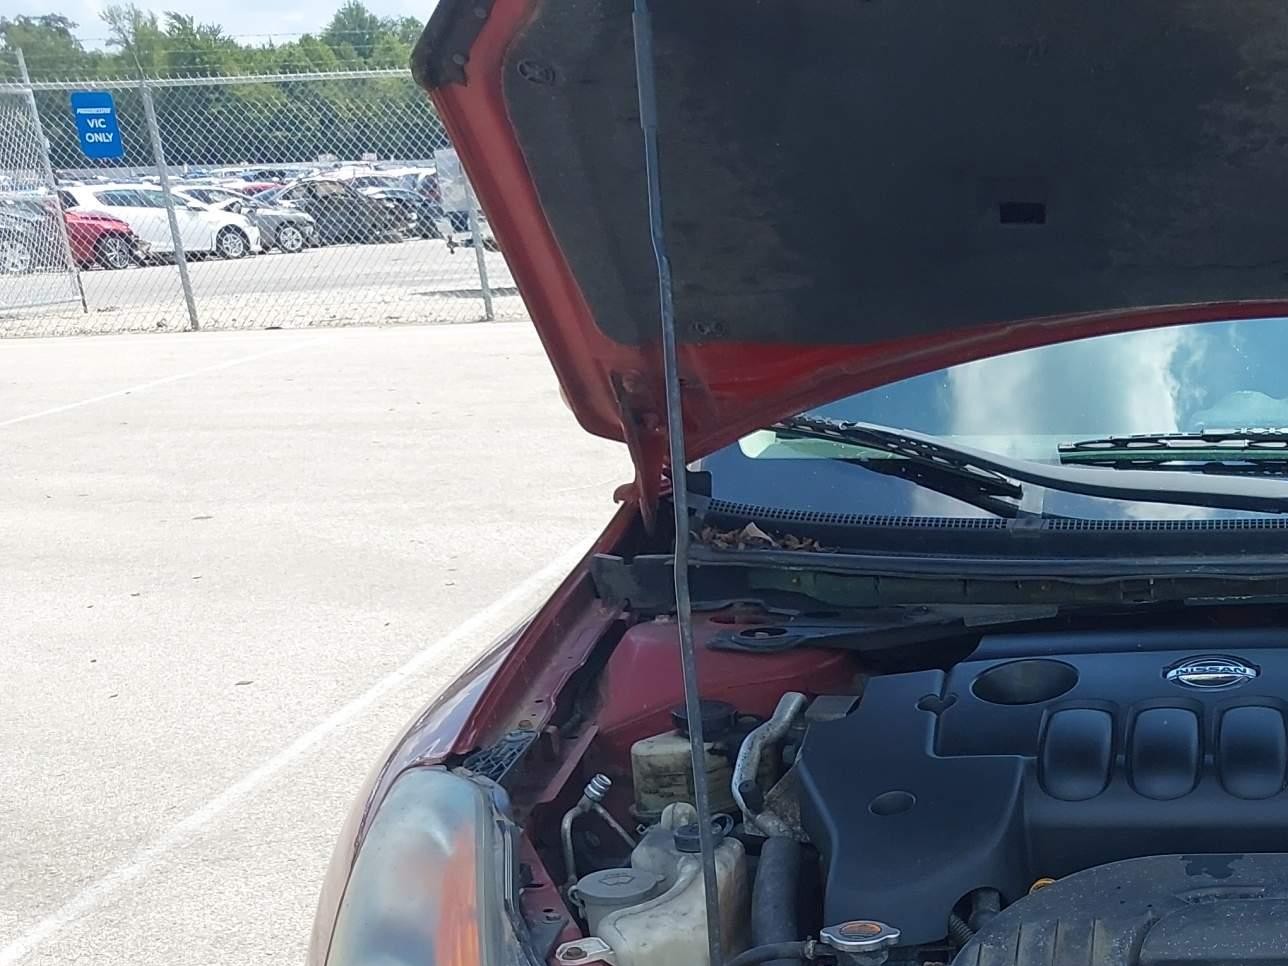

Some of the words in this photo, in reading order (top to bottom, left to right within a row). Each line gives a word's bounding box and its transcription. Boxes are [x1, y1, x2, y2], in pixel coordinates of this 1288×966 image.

[86, 118, 107, 129] VIC
[85, 132, 114, 143] ONLY
[1175, 666, 1248, 675] NISSAN
